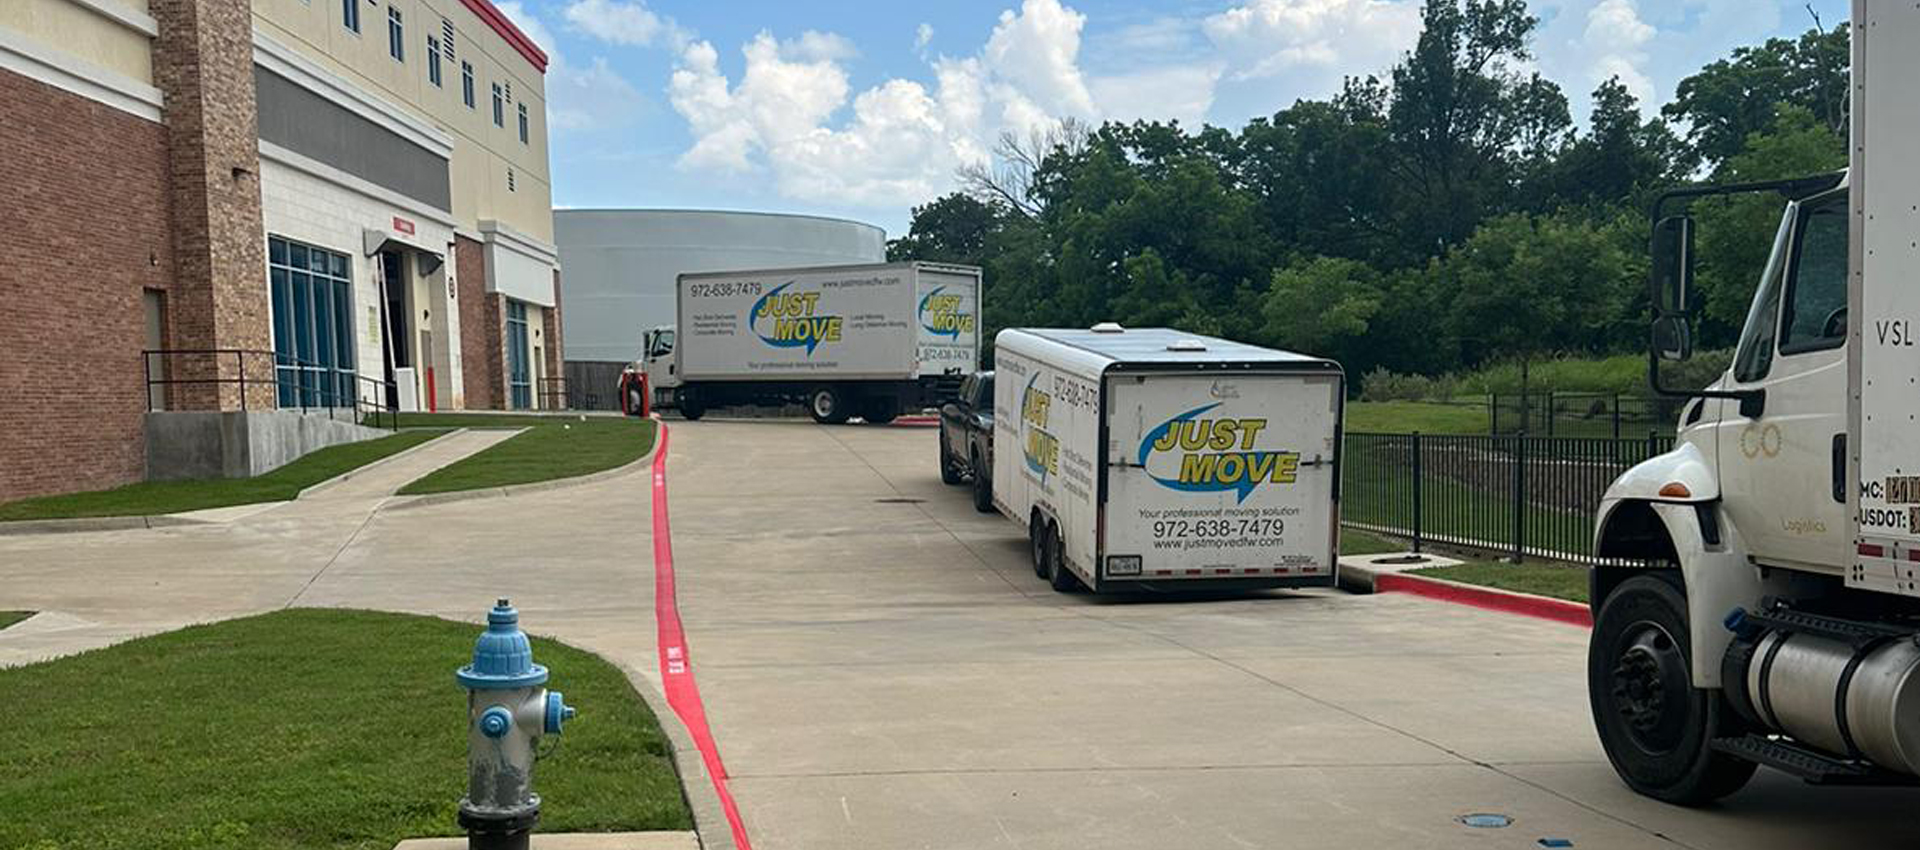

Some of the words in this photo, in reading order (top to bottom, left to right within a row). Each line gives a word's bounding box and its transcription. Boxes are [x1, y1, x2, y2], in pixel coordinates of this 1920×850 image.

[690, 282, 761, 297] 972-638-7479
[757, 292, 820, 318] JUST
[922, 293, 961, 311] JUST
[774, 316, 843, 342] MOVE
[933, 310, 974, 333] MOVE
[1876, 320, 1913, 346] VSL
[1023, 385, 1051, 430] JUST
[1154, 418, 1267, 451] JUST
[1179, 451, 1300, 485] MOVE
[1860, 480, 1884, 499] MC:
[1139, 508, 1161, 519] Your
[1162, 507, 1222, 519] professional
[1223, 507, 1260, 518] moving
[1262, 506, 1299, 516] solution
[1860, 508, 1907, 529] USDOT:
[1153, 518, 1284, 538] 972-638-7479
[1153, 537, 1284, 551] www.justmovedfw.com
